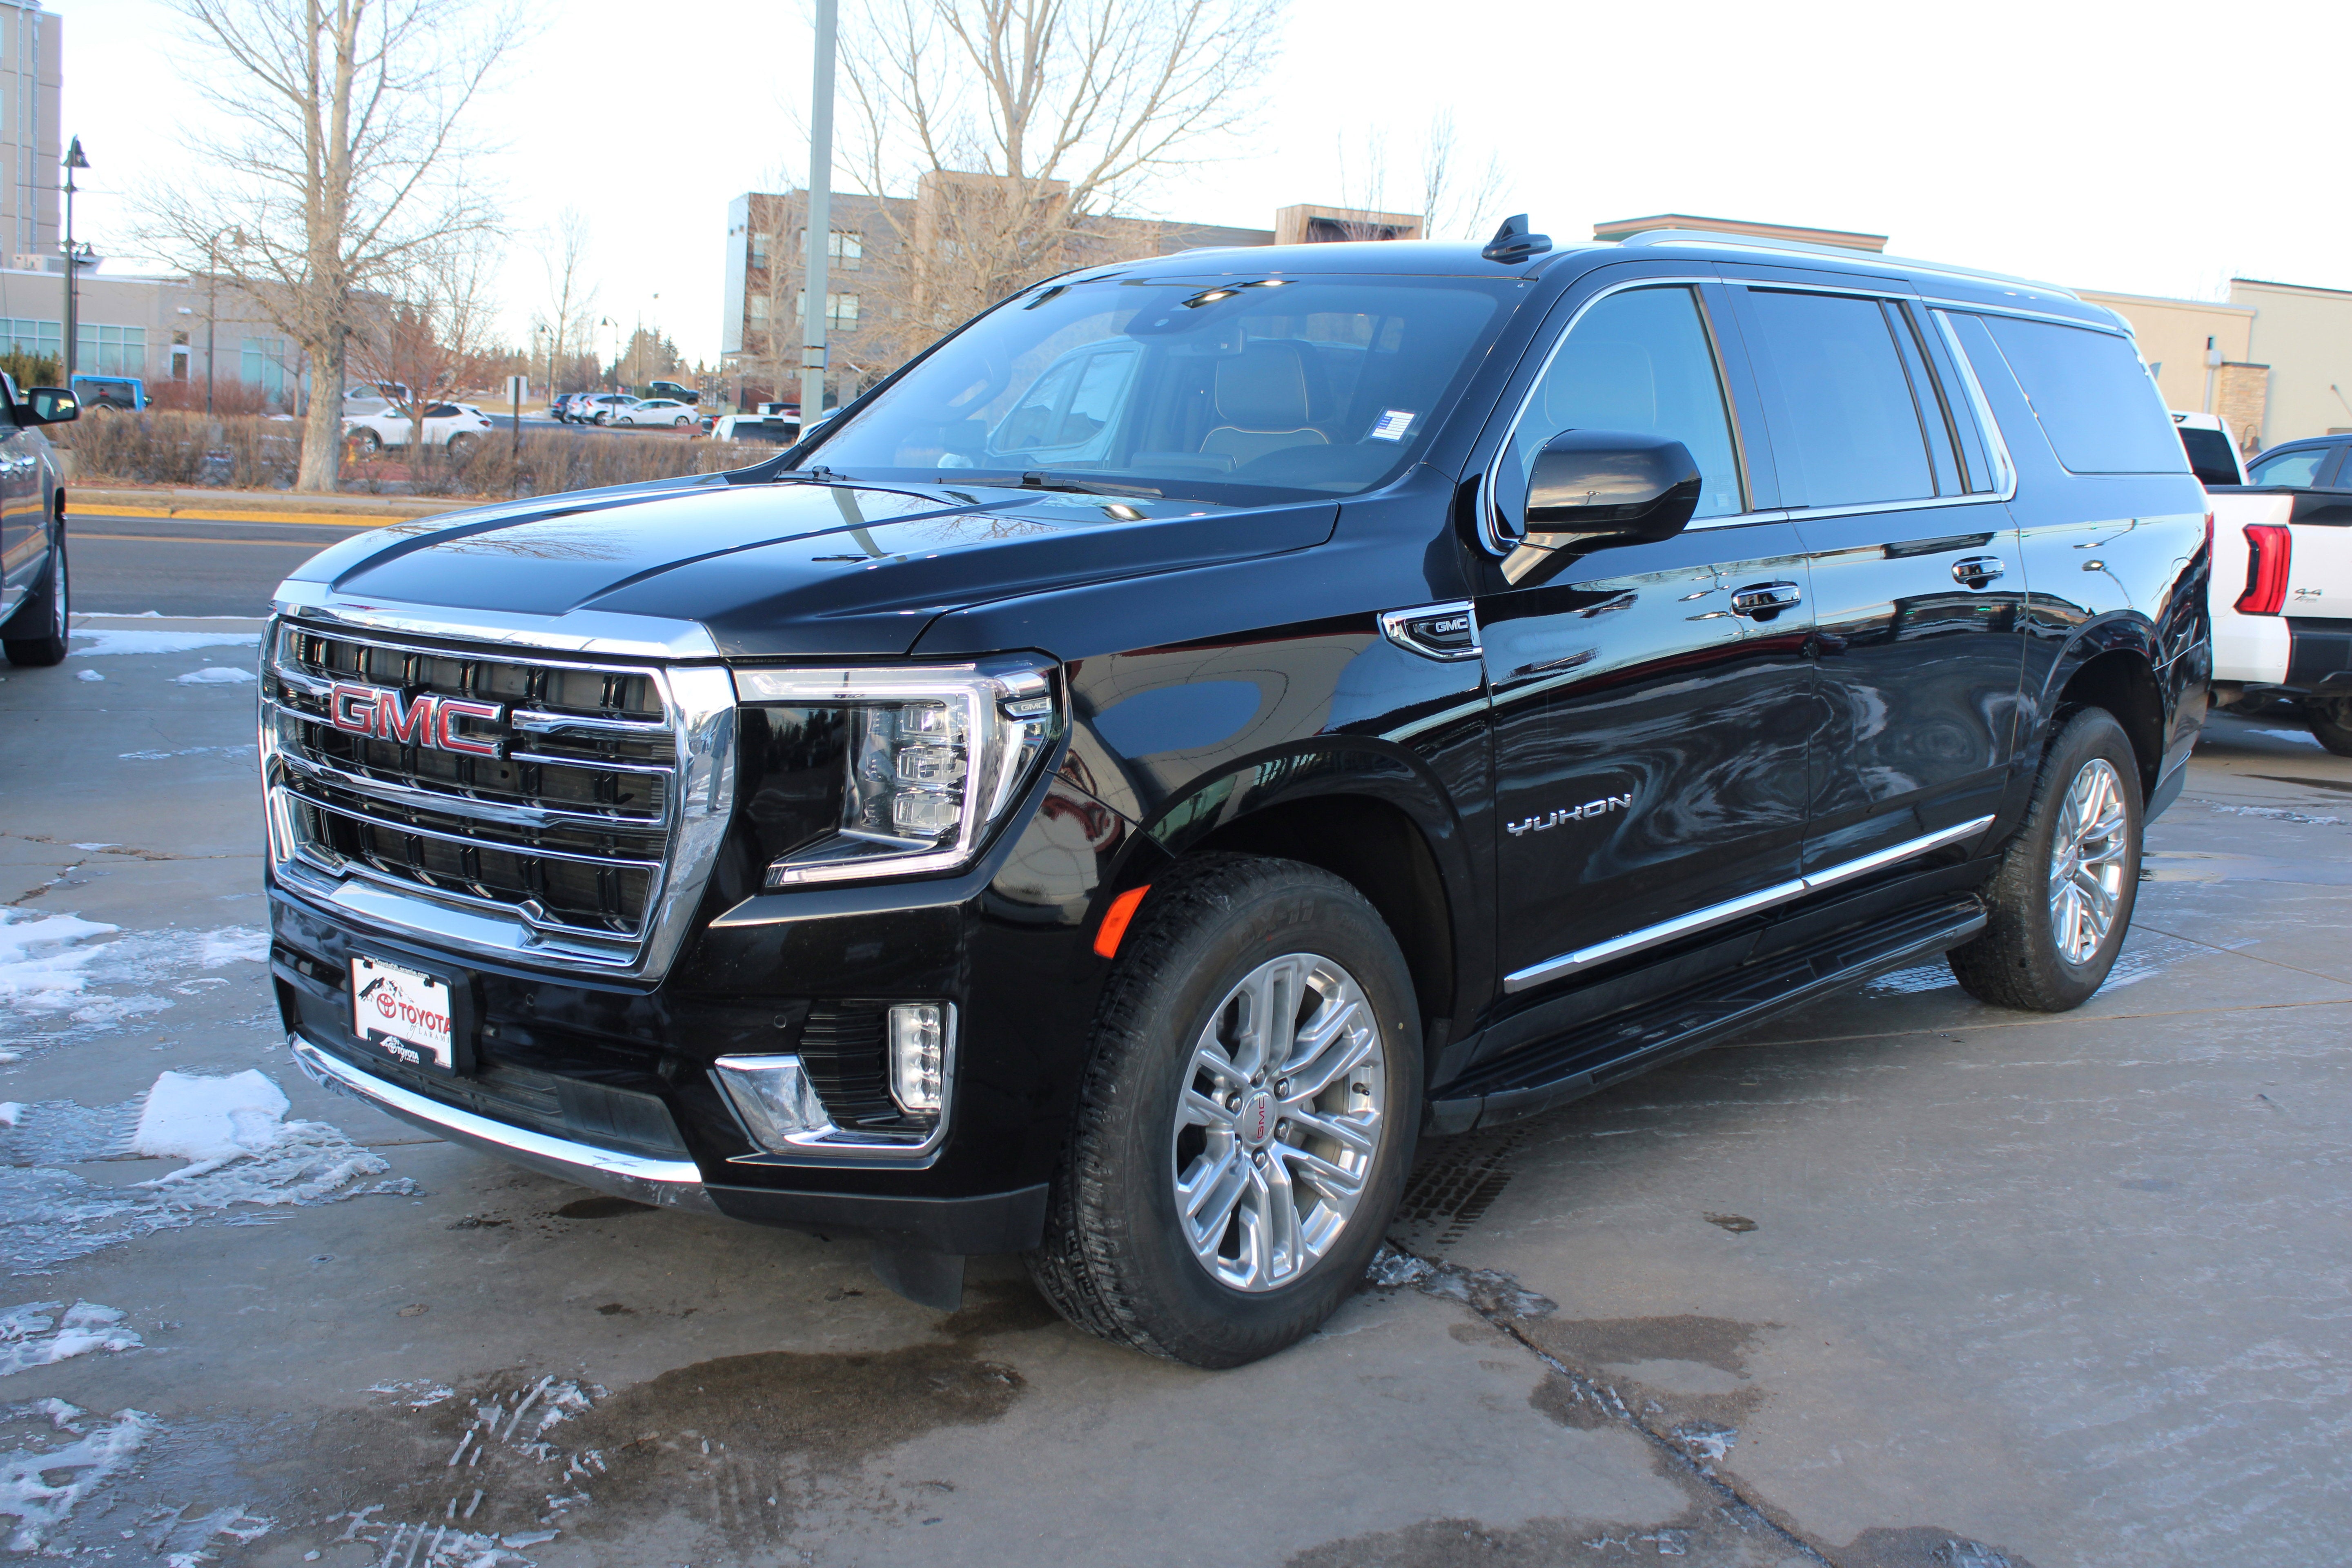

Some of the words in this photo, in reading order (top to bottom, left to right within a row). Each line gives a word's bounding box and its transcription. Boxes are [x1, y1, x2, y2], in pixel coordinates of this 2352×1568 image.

[1436, 618, 1468, 633] GMC
[1021, 702, 1047, 711] GMC
[332, 682, 502, 760] GMC
[1507, 793, 1632, 837] YUKON
[399, 1002, 450, 1034] TOYOTA
[407, 1022, 419, 1040] of
[396, 1046, 419, 1060] TOYOTA
